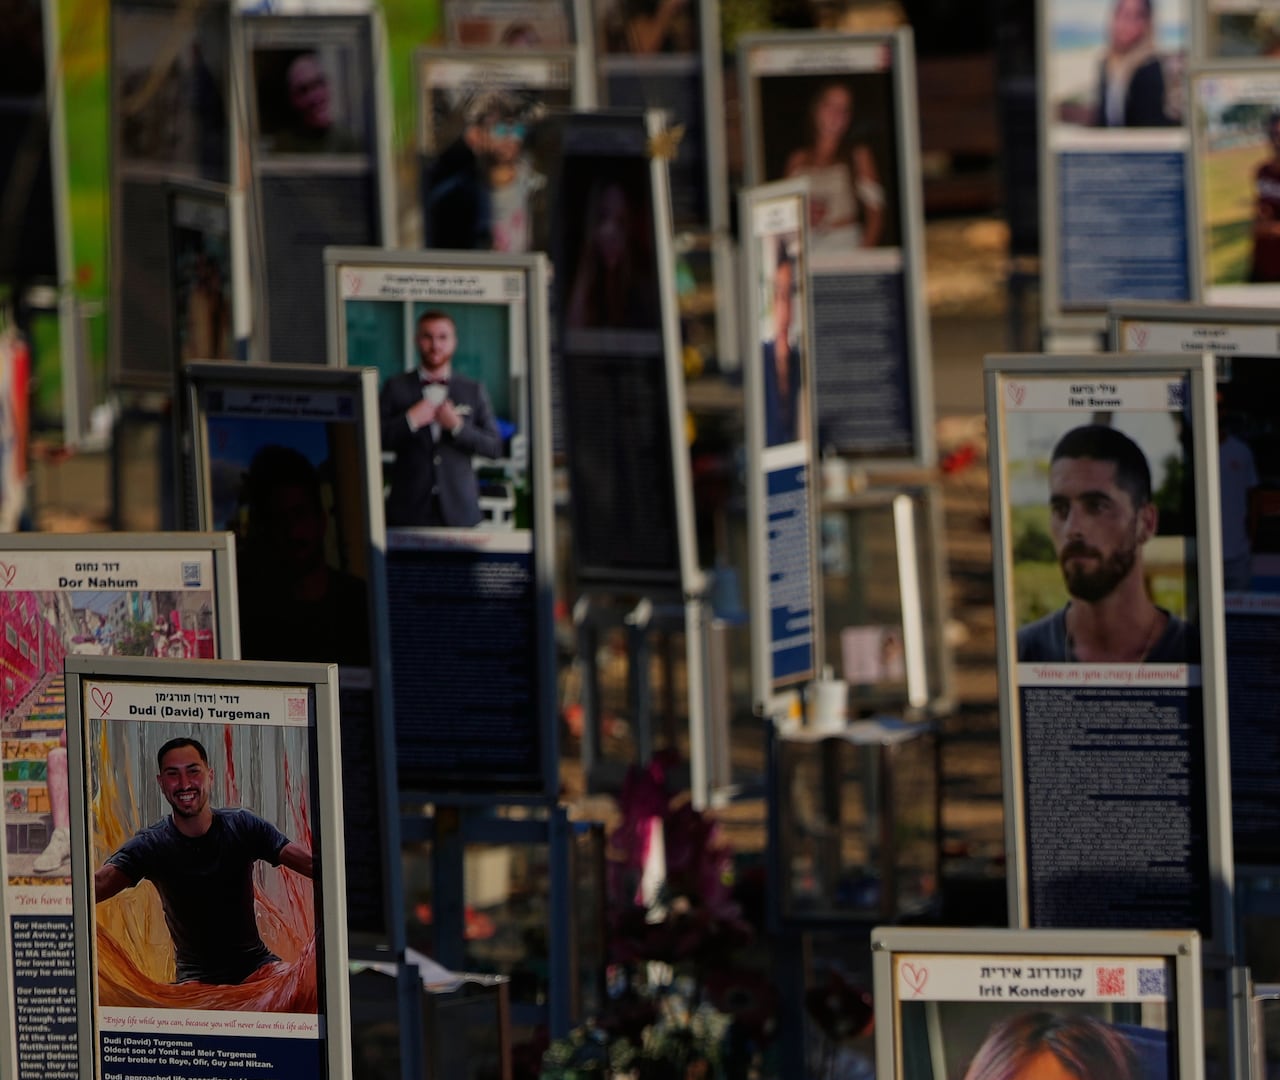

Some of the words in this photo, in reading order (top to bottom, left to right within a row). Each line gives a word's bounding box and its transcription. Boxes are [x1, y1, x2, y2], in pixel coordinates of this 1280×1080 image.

[74, 563, 98, 571] נחום
[103, 563, 119, 571] דור
[58, 577, 83, 587] Dor
[87, 577, 138, 587] Nahum
[129, 705, 156, 715] Dudi
[160, 706, 203, 718] (David)
[207, 708, 269, 720] Turgeman
[980, 967, 1021, 977] אירית
[1028, 967, 1082, 980] קונדרוב
[979, 985, 1002, 996] Irit
[1008, 985, 1085, 996] Konderov
[103, 1016, 127, 1026] “Enjoy
[126, 1016, 138, 1027] life
[156, 1019, 169, 1028] you
[184, 1018, 209, 1026] because
[210, 1021, 223, 1030] you
[256, 1021, 272, 1029] leave
[272, 1021, 286, 1029] this
[286, 1022, 297, 1032] life
[297, 1022, 317, 1030] alive.”
[123, 1037, 151, 1046] (David)
[152, 1038, 192, 1047] Turgeman
[216, 1050, 256, 1058] Turgeman
[192, 1058, 209, 1066] Ofir,
[211, 1058, 227, 1067] Guy
